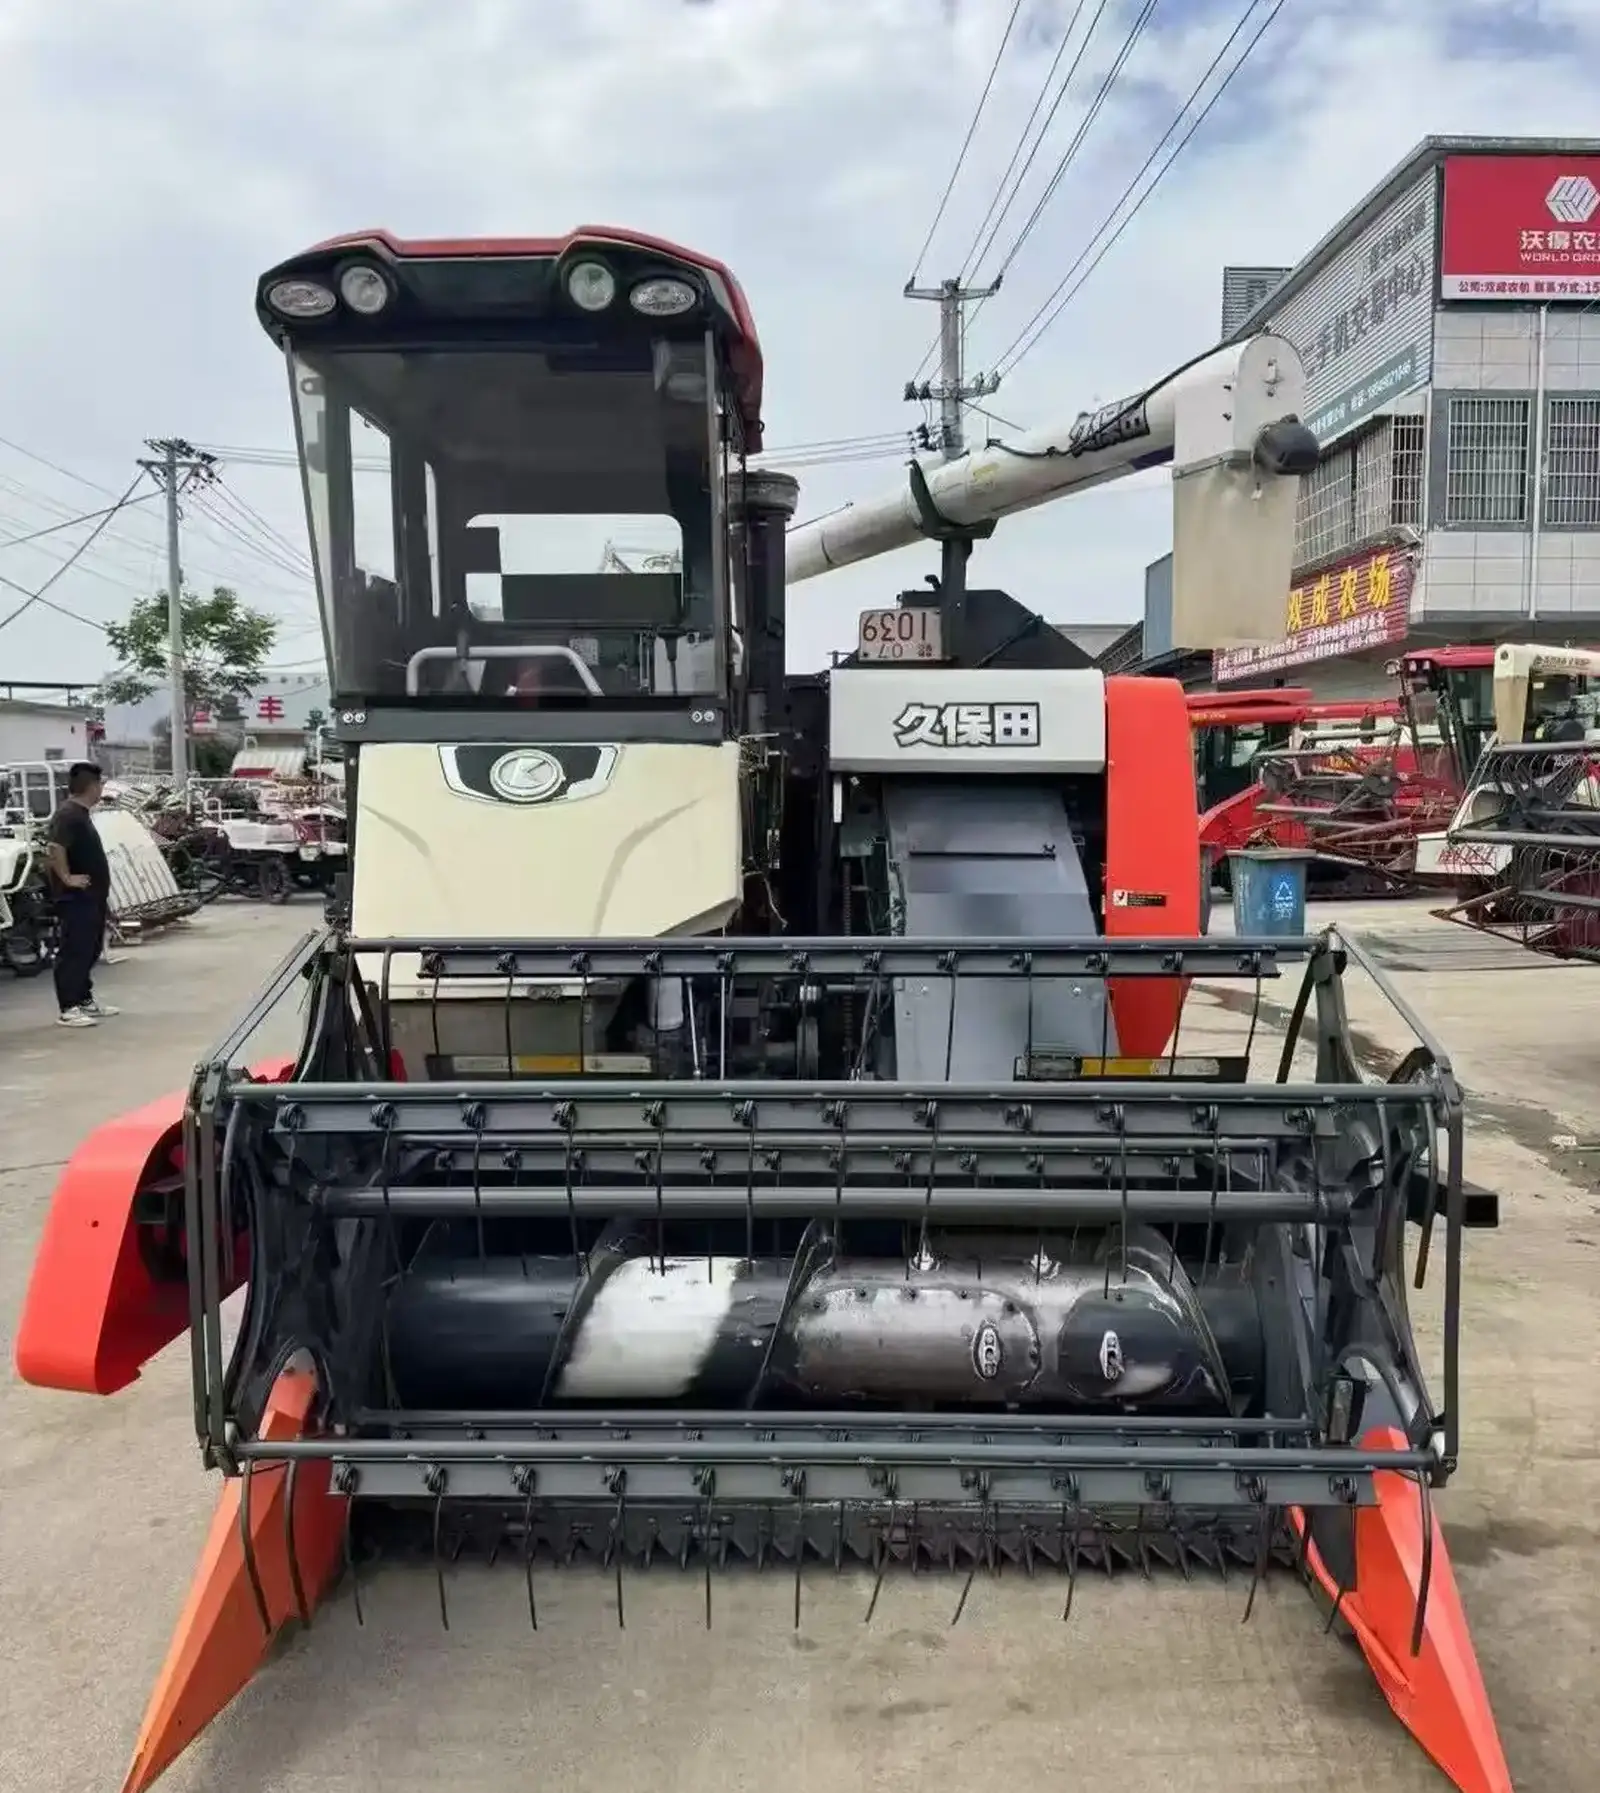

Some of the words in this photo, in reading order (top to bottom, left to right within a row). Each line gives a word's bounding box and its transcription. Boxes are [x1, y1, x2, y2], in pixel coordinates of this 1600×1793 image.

[1520, 230, 1600, 250] 沃得农
[1520, 253, 1569, 262] WORLD
[863, 611, 927, 641] 1039
[893, 702, 1040, 747] 久保田
